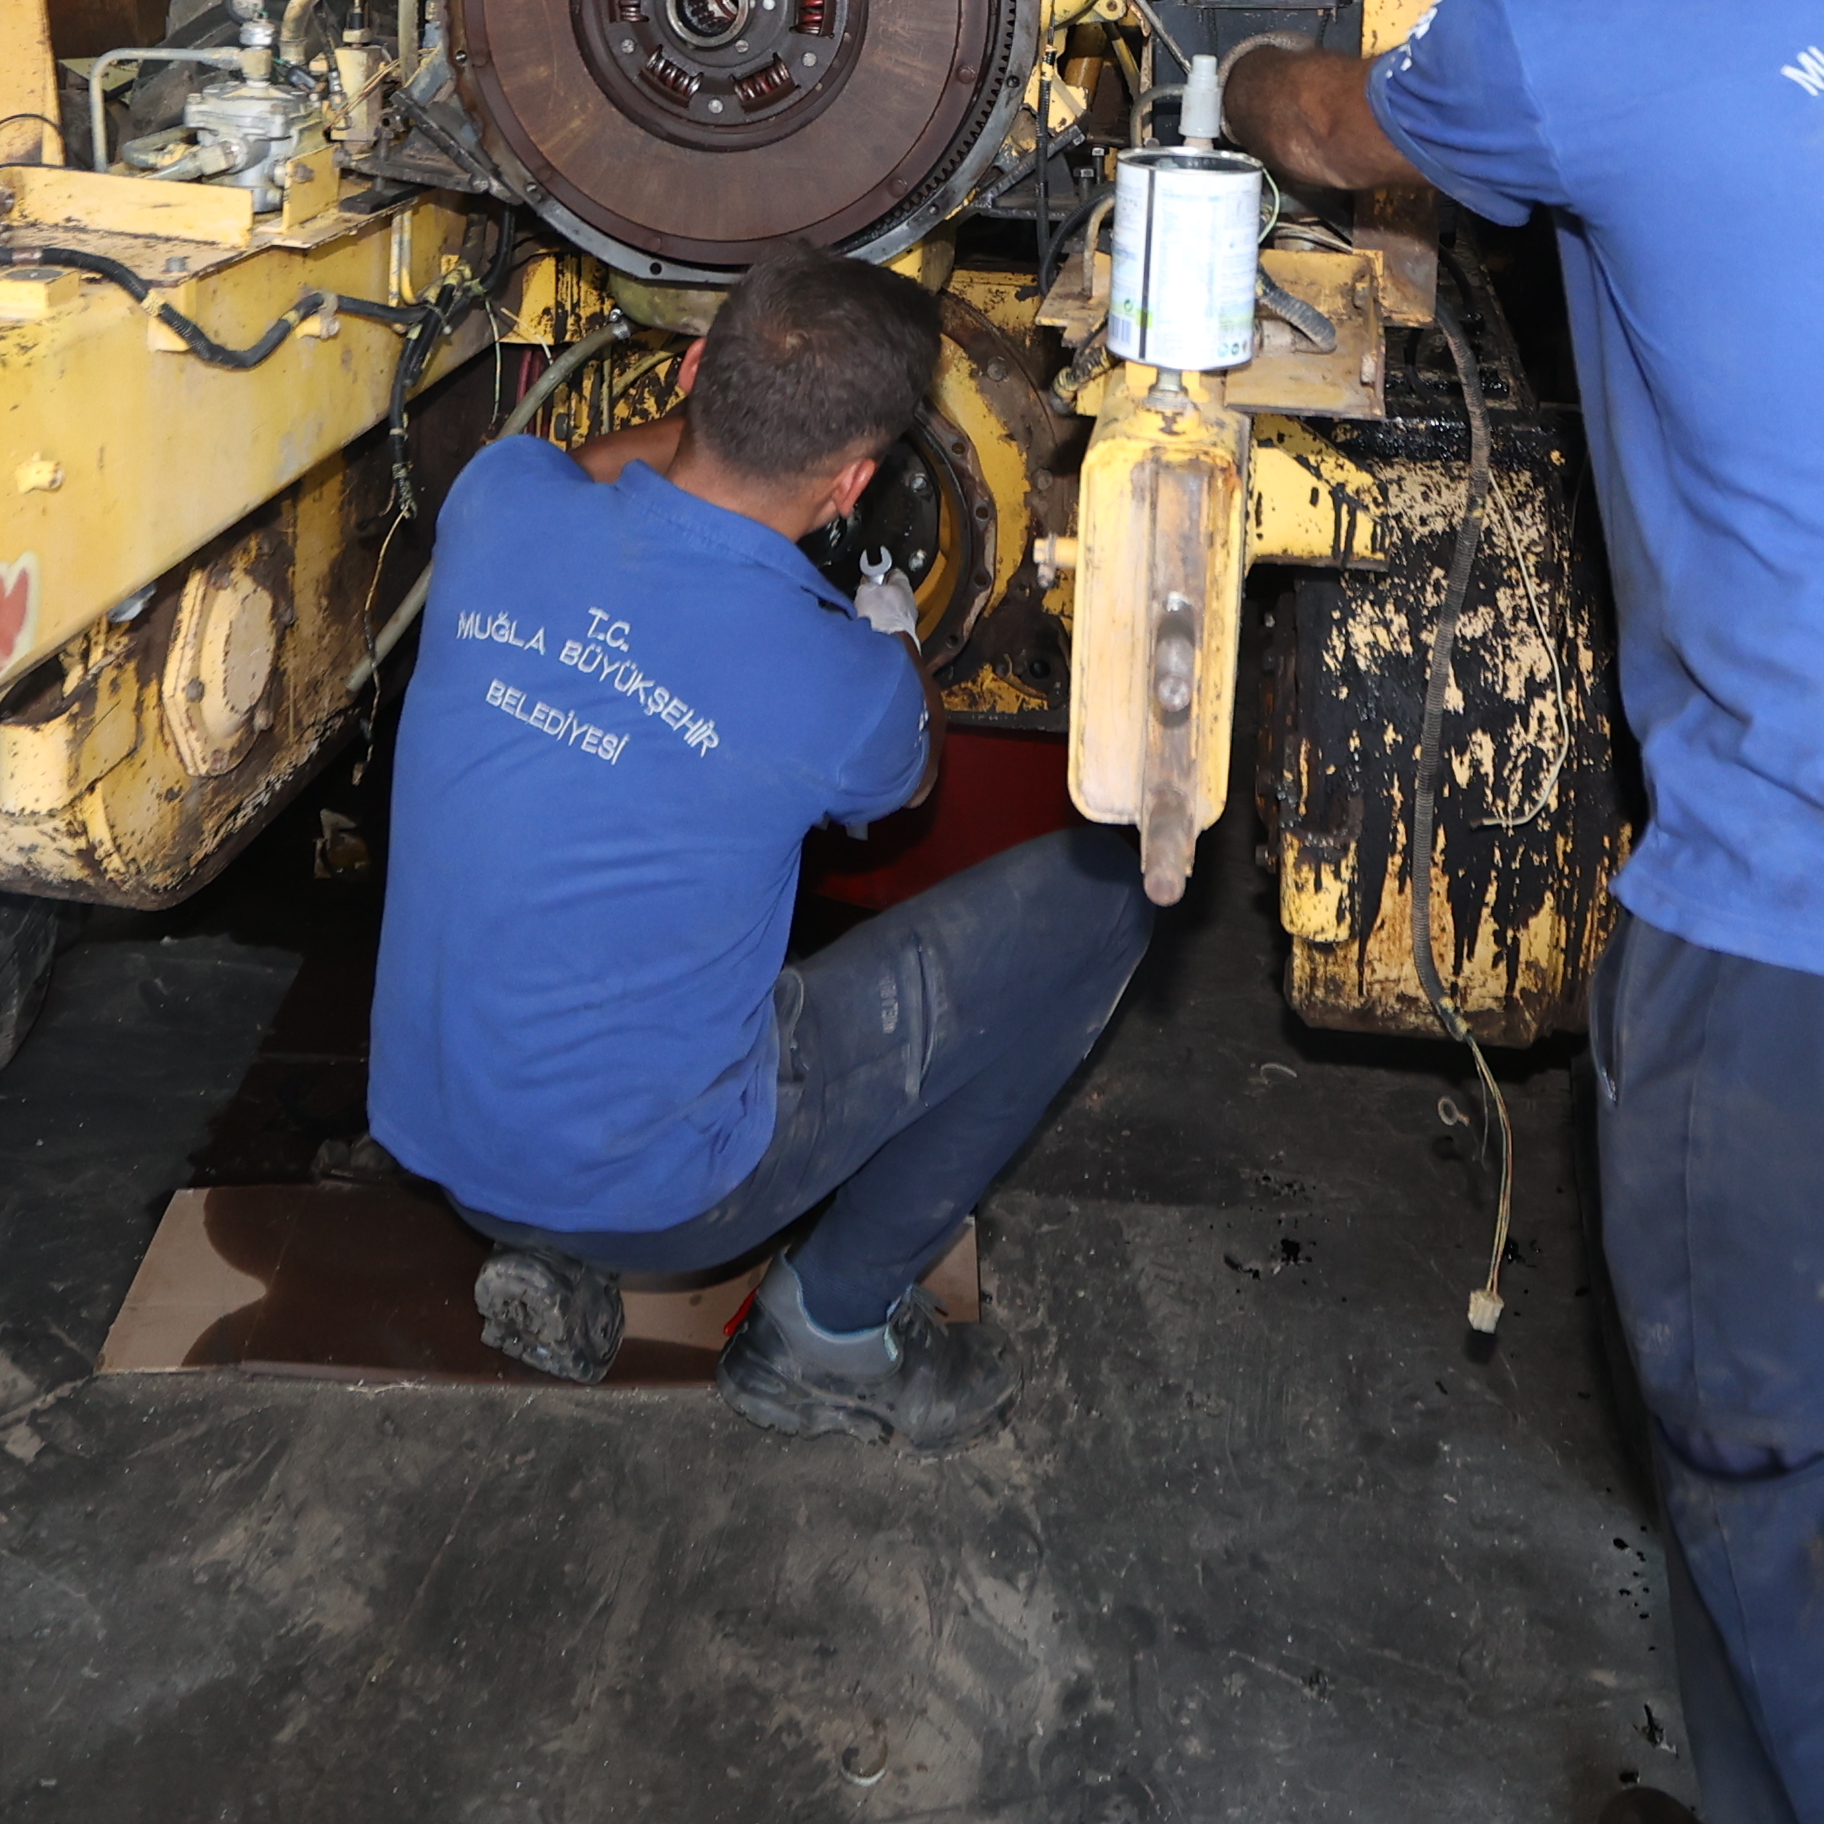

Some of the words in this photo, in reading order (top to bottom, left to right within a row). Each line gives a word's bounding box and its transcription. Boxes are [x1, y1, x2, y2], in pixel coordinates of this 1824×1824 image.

[588, 606, 631, 653] T.C.
[456, 609, 546, 656] MUĞLA
[558, 639, 720, 758] BÜYÜKŞEHİR
[484, 678, 632, 766] BELEDİYESİ
